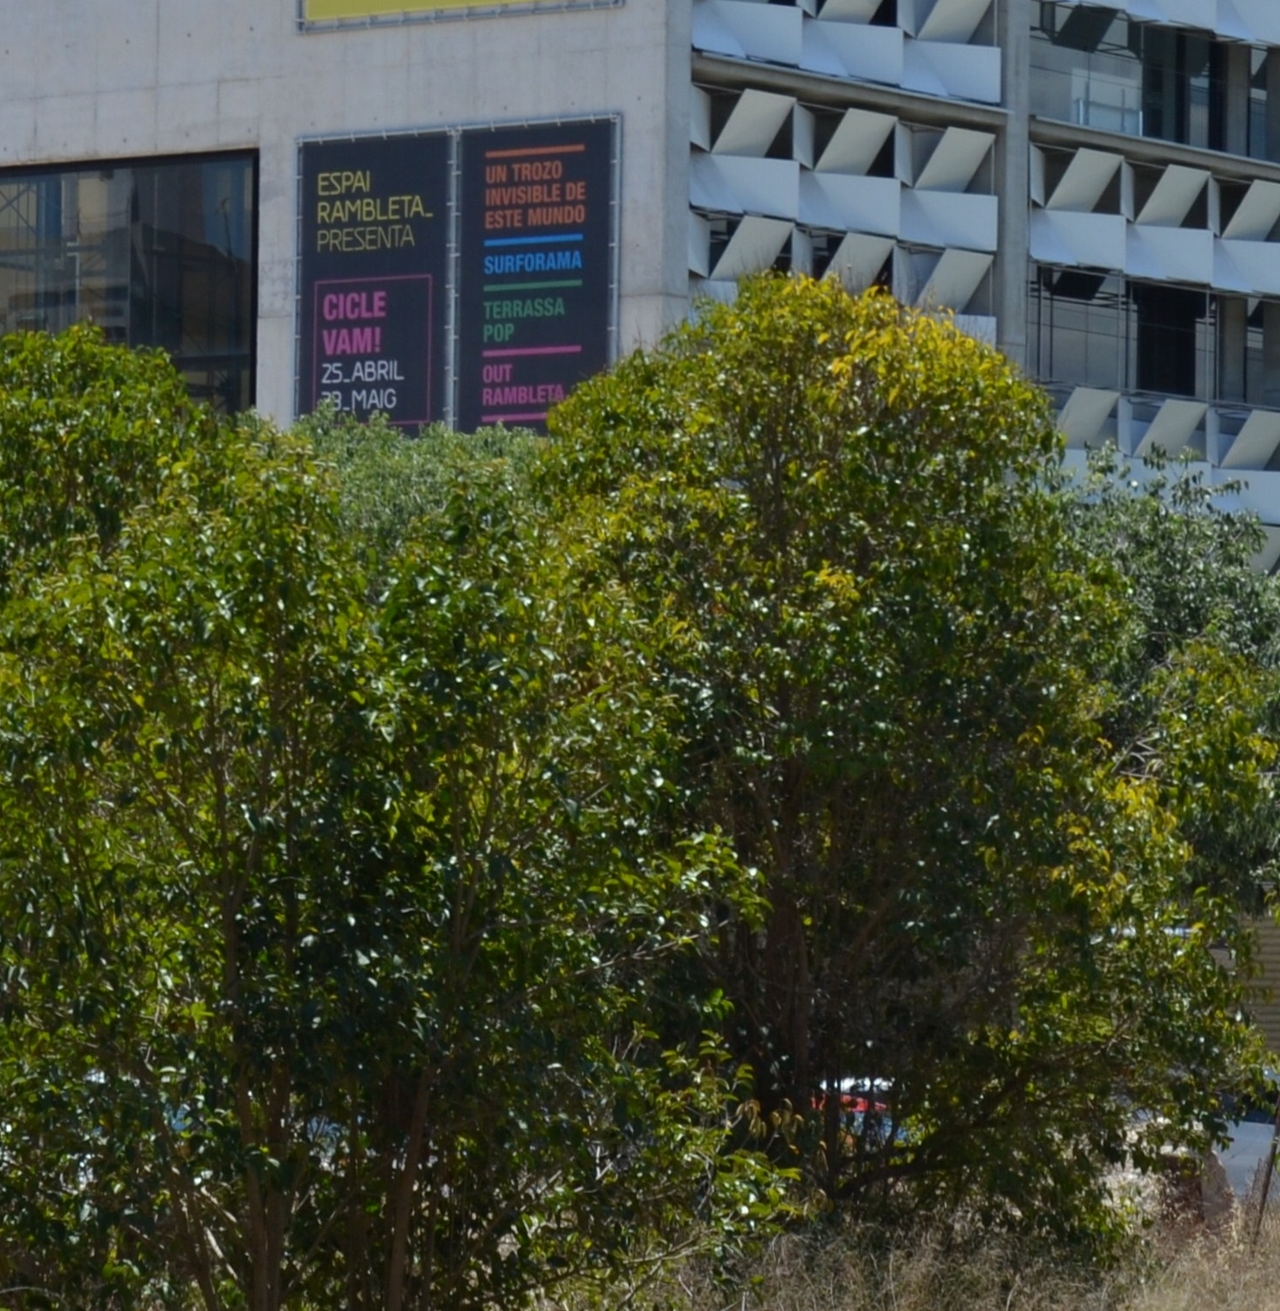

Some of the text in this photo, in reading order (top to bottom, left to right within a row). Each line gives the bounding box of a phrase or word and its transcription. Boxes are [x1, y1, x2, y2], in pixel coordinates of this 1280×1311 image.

[317, 170, 371, 196] ESPAI
[485, 160, 563, 184] UN TROZO
[485, 182, 586, 207] INVISIBLE DE
[485, 205, 585, 229] ESTE MUNDO
[317, 224, 415, 252] PRESENTA
[483, 250, 583, 275] SURFORAMA
[323, 291, 387, 321] CICLE
[483, 297, 565, 320] TERRASSA
[323, 326, 381, 356] VAM!
[483, 323, 515, 343] POP
[483, 364, 513, 384] OUT
[483, 383, 564, 406] RAMBLETA
